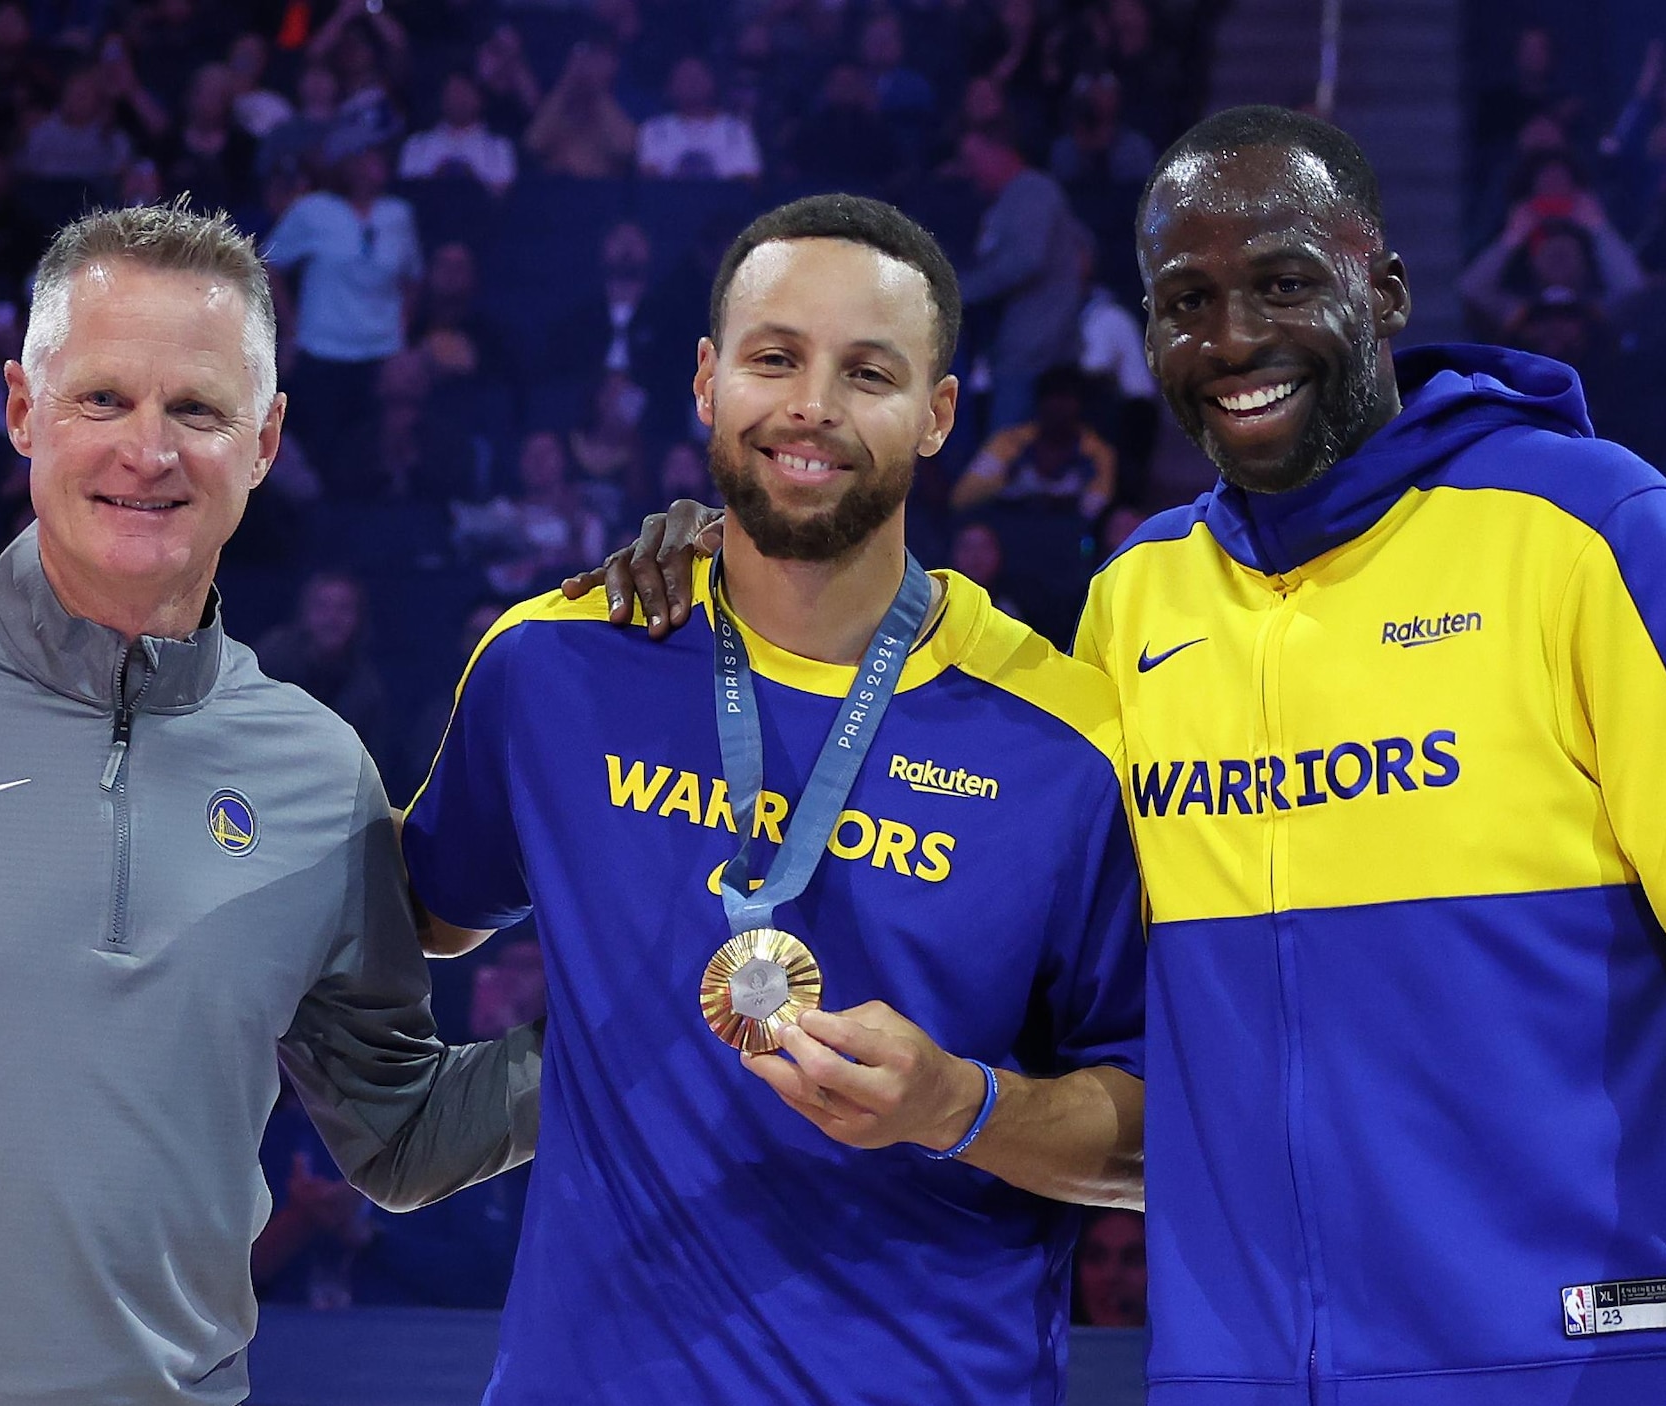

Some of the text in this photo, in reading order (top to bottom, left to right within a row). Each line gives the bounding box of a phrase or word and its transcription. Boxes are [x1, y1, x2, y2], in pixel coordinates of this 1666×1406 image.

[1381, 611, 1483, 649] Rakuten
[866, 636, 898, 686] 2024
[888, 754, 1000, 800] Rakuten
[1132, 728, 1461, 818] WARRIORS
[604, 753, 957, 883] WARRORS
[1599, 1291, 1614, 1303] XL
[1602, 1309, 1623, 1326] 23
